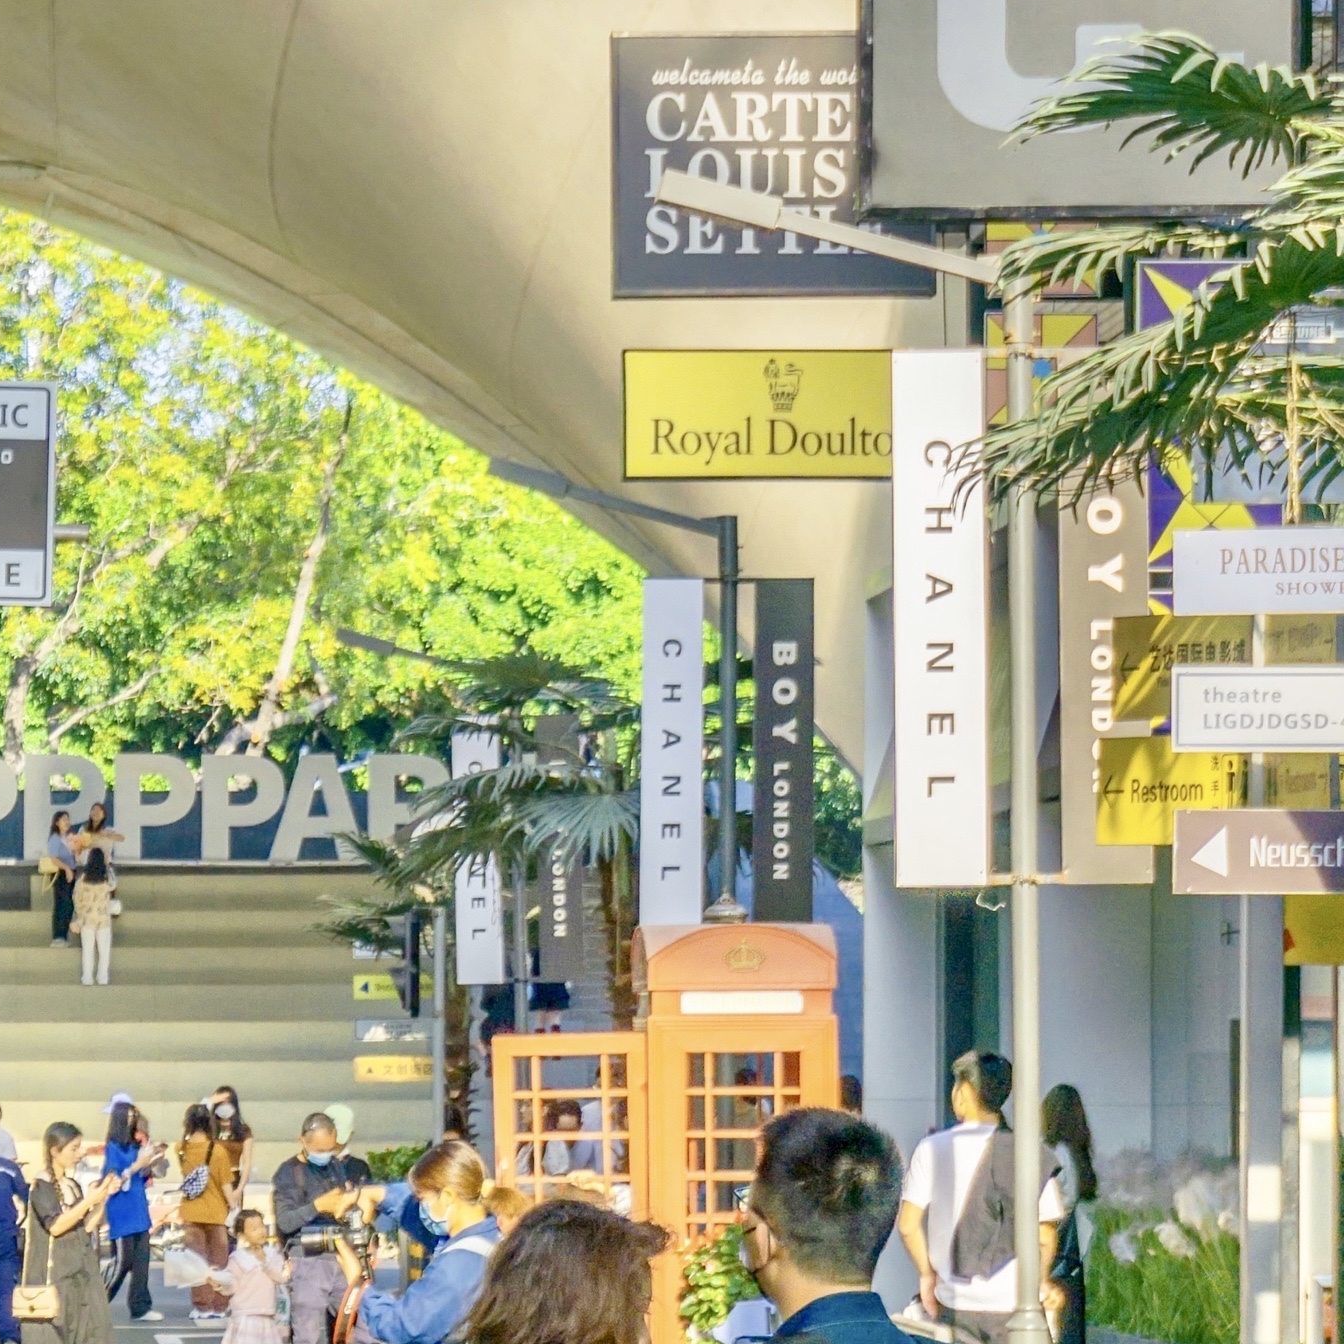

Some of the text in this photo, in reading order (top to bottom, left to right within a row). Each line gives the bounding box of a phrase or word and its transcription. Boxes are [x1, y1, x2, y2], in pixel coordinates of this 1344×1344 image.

[774, 58, 810, 85] the
[646, 91, 858, 142] CARTE
[651, 416, 892, 465] Royal Doulto
[1220, 547, 1344, 574] PARADISE
[923, 439, 955, 798] CHANEL
[772, 641, 798, 745] BOY
[1202, 687, 1282, 703] theatre
[661, 639, 682, 881] CHANEL
[1131, 778, 1204, 803] Restroom
[773, 761, 790, 880] LONDON
